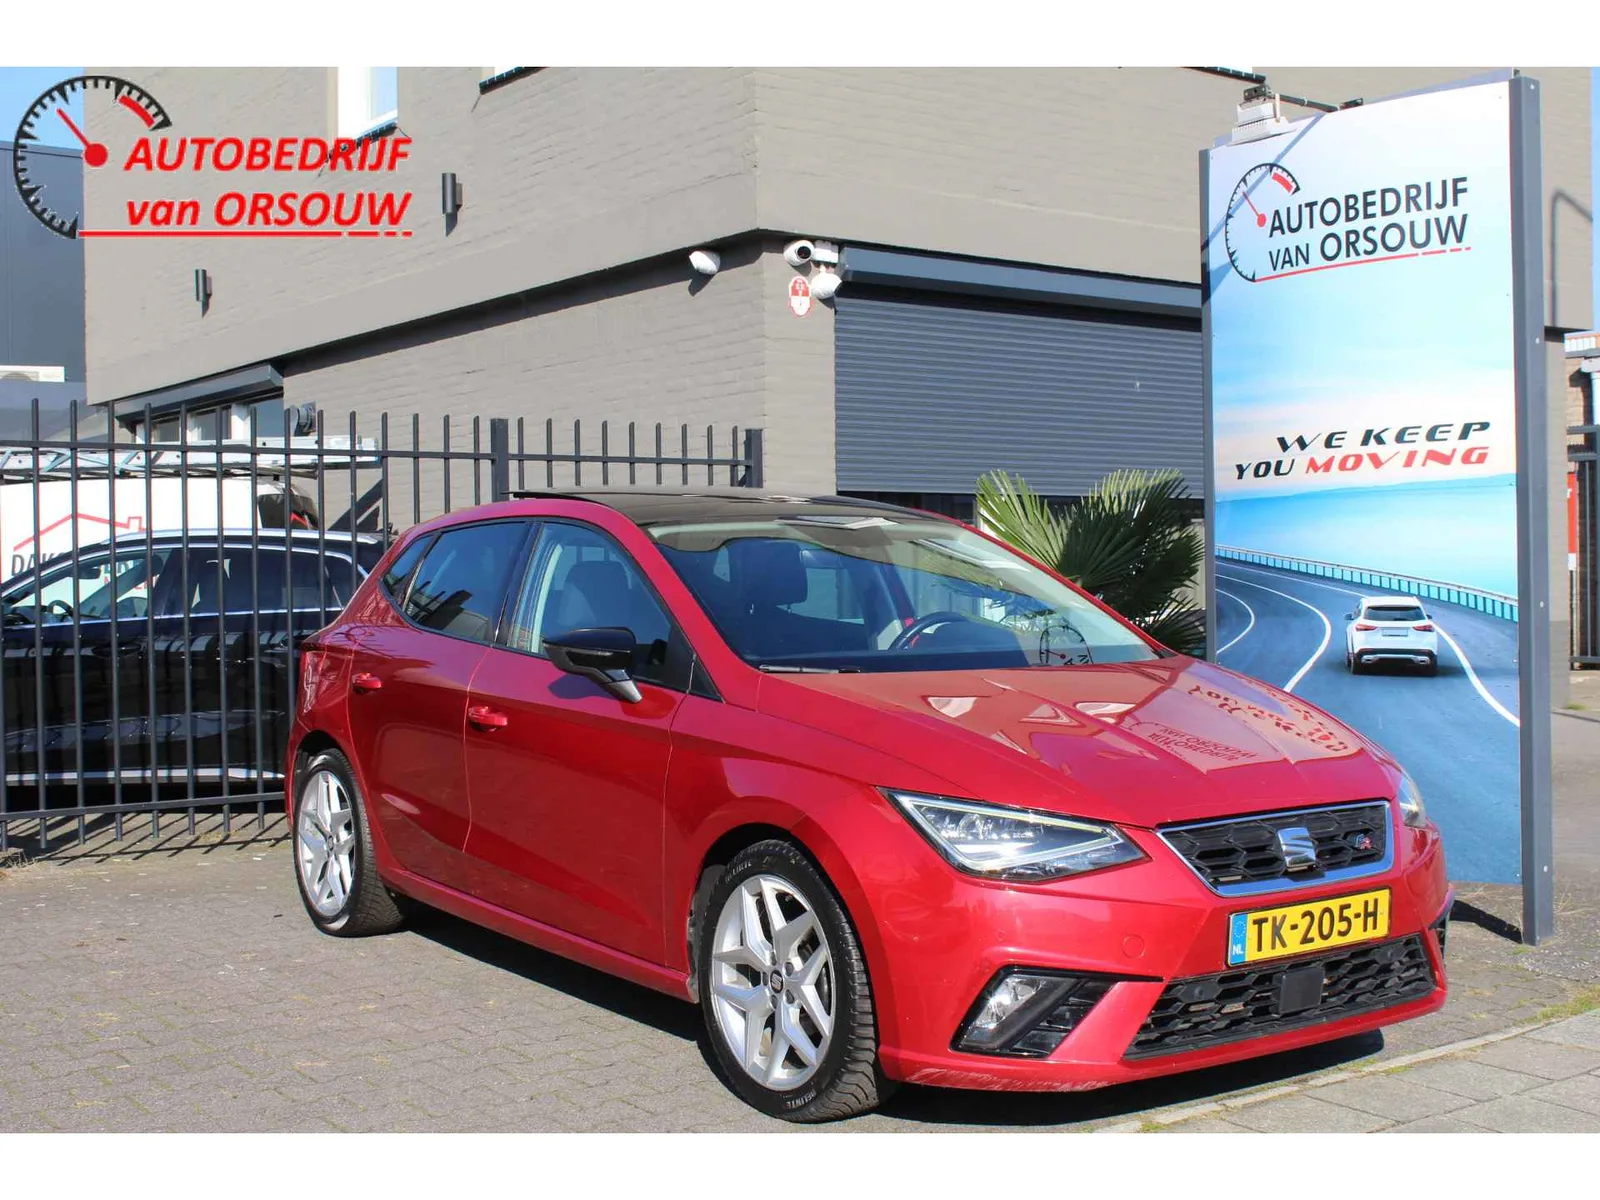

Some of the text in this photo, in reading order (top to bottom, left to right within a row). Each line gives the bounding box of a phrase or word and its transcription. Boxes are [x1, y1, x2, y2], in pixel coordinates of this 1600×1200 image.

[1268, 176, 1468, 239] AUTOBEDRIJF
[1268, 213, 1468, 272] VAN ORSOUW
[1276, 421, 1491, 453] WE KEEP
[1235, 446, 1490, 480] YOU MOVING
[1252, 898, 1378, 952] TK-205-H
[1232, 944, 1244, 955] NL
